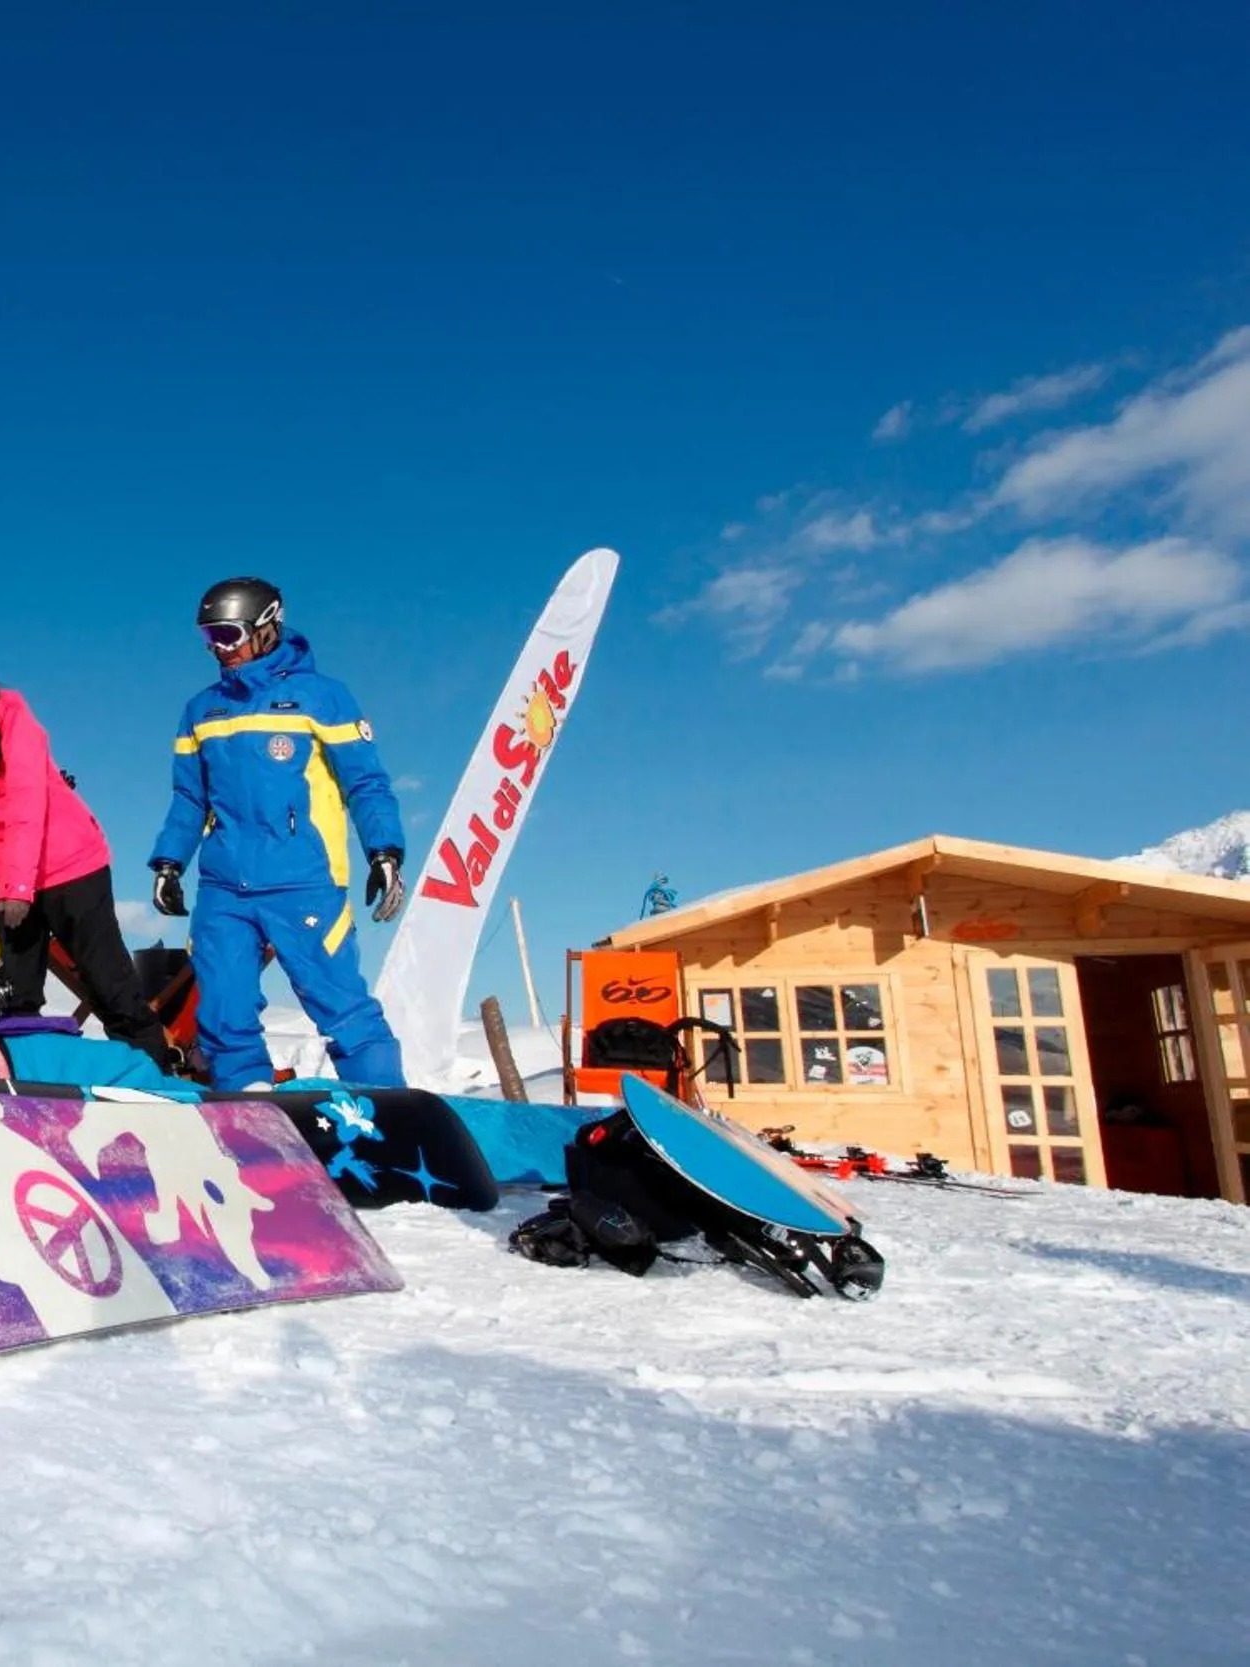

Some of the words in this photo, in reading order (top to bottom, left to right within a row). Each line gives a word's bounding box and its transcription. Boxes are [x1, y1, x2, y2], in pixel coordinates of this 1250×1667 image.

[493, 650, 577, 787] Sole
[493, 776, 522, 831] di
[421, 814, 500, 908] Val
